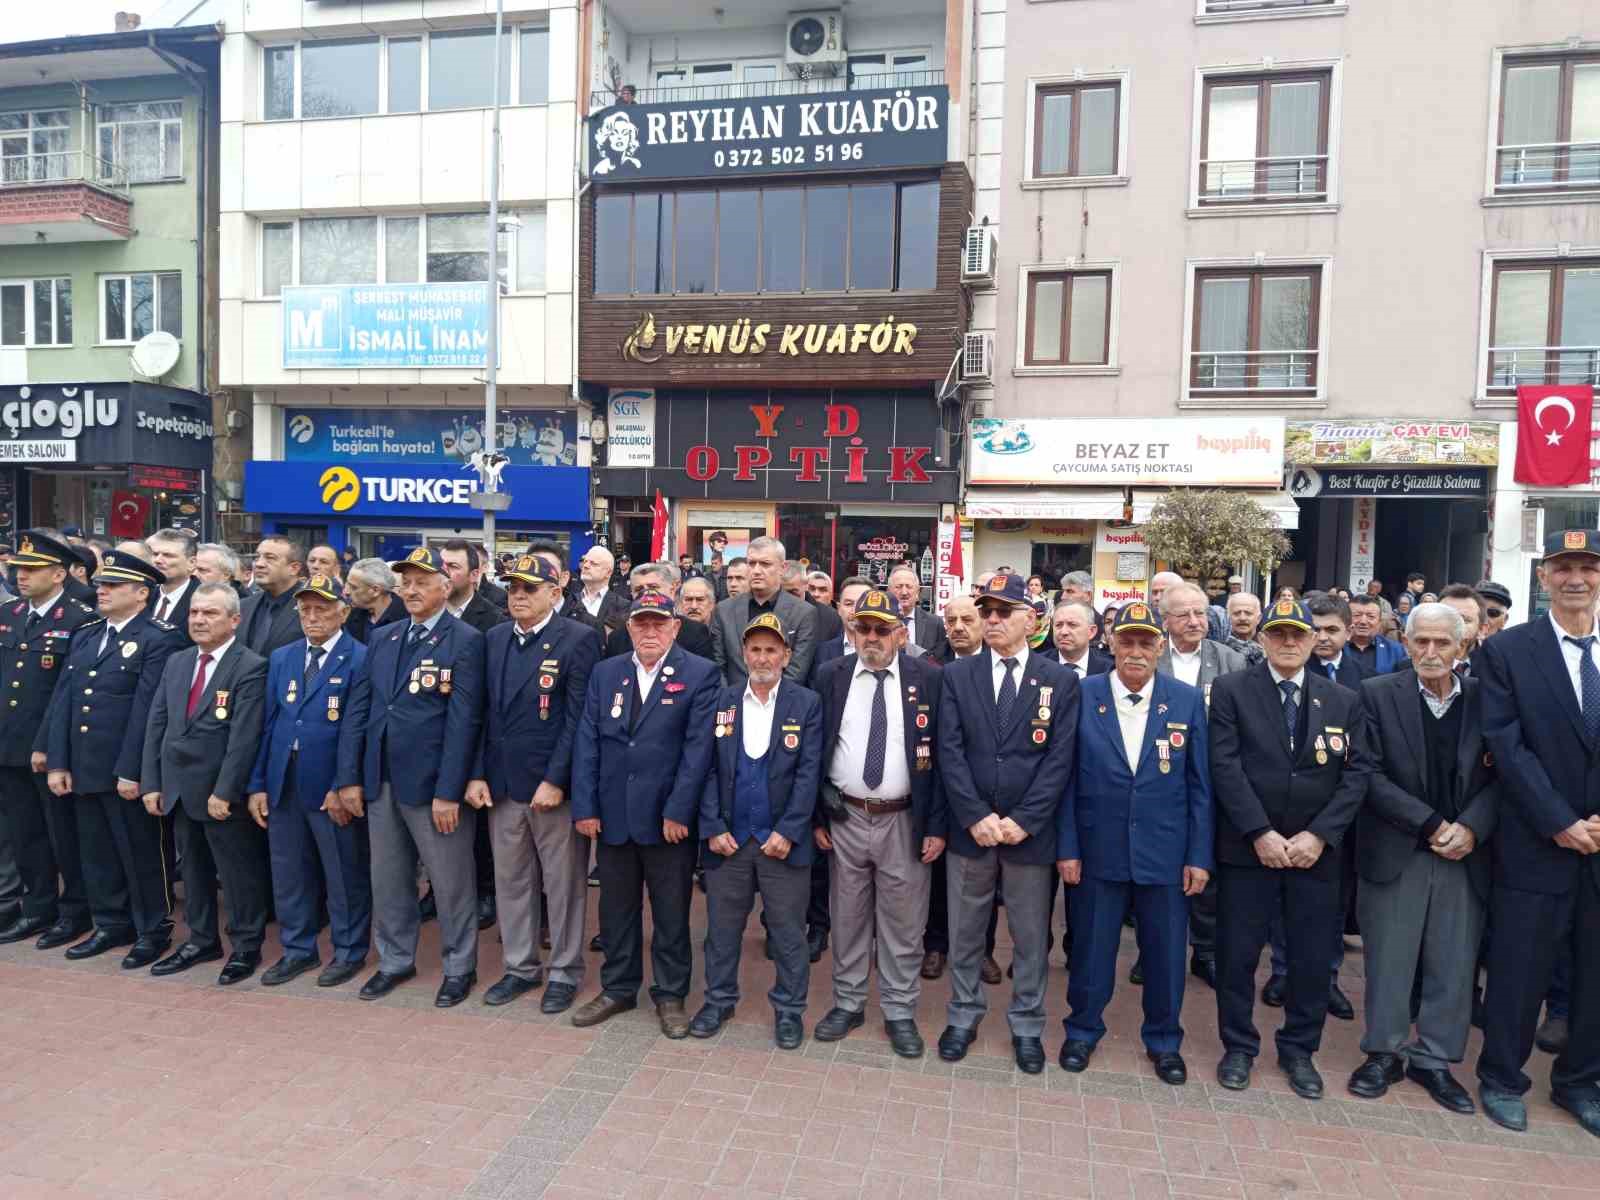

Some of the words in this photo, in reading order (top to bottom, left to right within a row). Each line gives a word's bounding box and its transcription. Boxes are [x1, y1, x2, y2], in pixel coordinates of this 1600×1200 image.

[646, 104, 785, 145] REYHAN
[799, 90, 939, 137] KUAFÖR
[714, 151, 725, 168] 0
[728, 149, 764, 167] 372
[771, 147, 806, 165] 502
[815, 145, 834, 163] 51
[840, 142, 864, 161] 96
[348, 324, 427, 351] İSMAİL
[665, 317, 772, 355] VENÜS
[778, 314, 919, 357] KUAFÖR
[0, 386, 118, 439] çioğlu
[614, 401, 640, 416] SGK
[136, 410, 213, 440] Sepetçioğlu
[328, 424, 395, 439] Turkcell'le
[1393, 425, 1432, 440] ÇAY
[1438, 422, 1473, 438] EVİ
[28, 443, 67, 458] SALONU
[332, 439, 379, 456] bağlan
[382, 440, 436, 457] hayata!
[1075, 443, 1140, 459] BEYAZ
[1146, 443, 1170, 459] ET
[685, 436, 932, 483] OPTİK
[1052, 463, 1108, 475] ÇAYCUMA
[1111, 463, 1142, 476] SATIŞ
[1144, 463, 1193, 473] NOKTASI
[362, 476, 485, 504] TURKCEL
[1328, 474, 1351, 489] Best
[1353, 474, 1389, 492] Kuaför
[1391, 475, 1401, 489] &
[1403, 473, 1443, 492] Güzellik
[1444, 474, 1481, 489] Salonu
